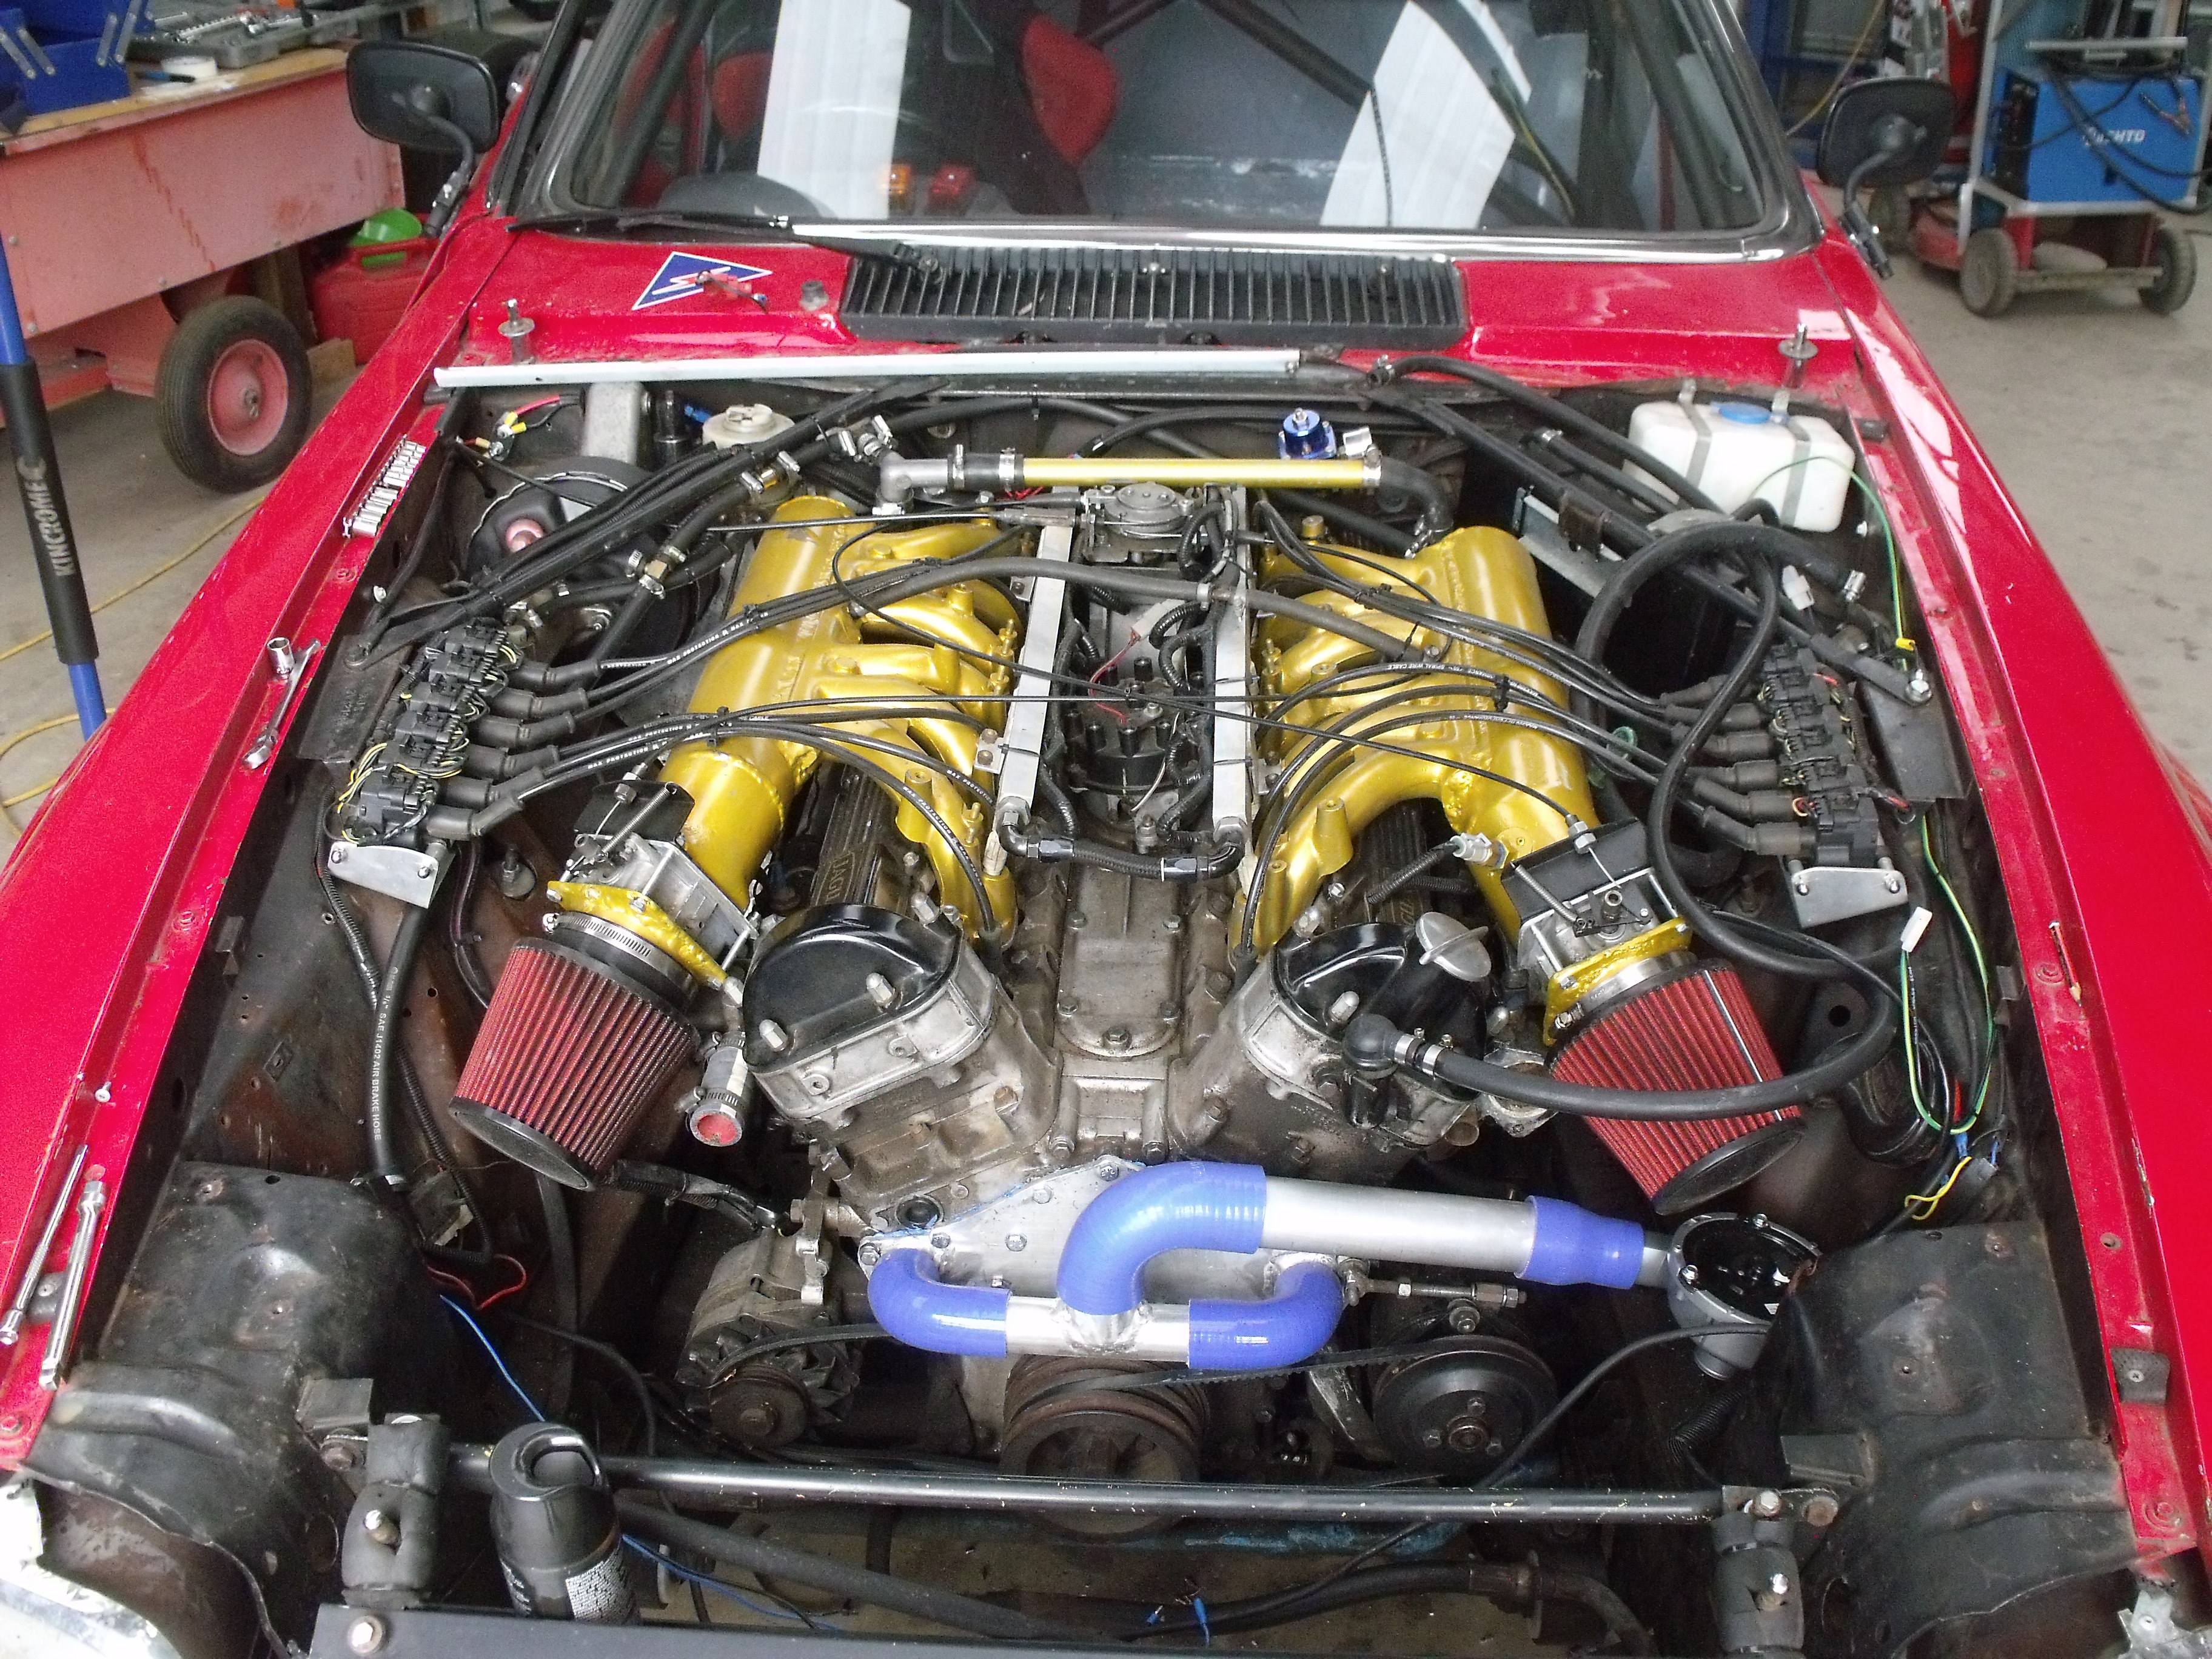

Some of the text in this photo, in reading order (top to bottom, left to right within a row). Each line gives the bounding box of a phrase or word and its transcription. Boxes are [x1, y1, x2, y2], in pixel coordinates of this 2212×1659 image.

[25, 481, 76, 577] KINCROME
[947, 769, 960, 779] MAX
[378, 1013, 387, 1031] SAE
[374, 1033, 383, 1059] J1402
[372, 1114, 381, 1141] HOSE
